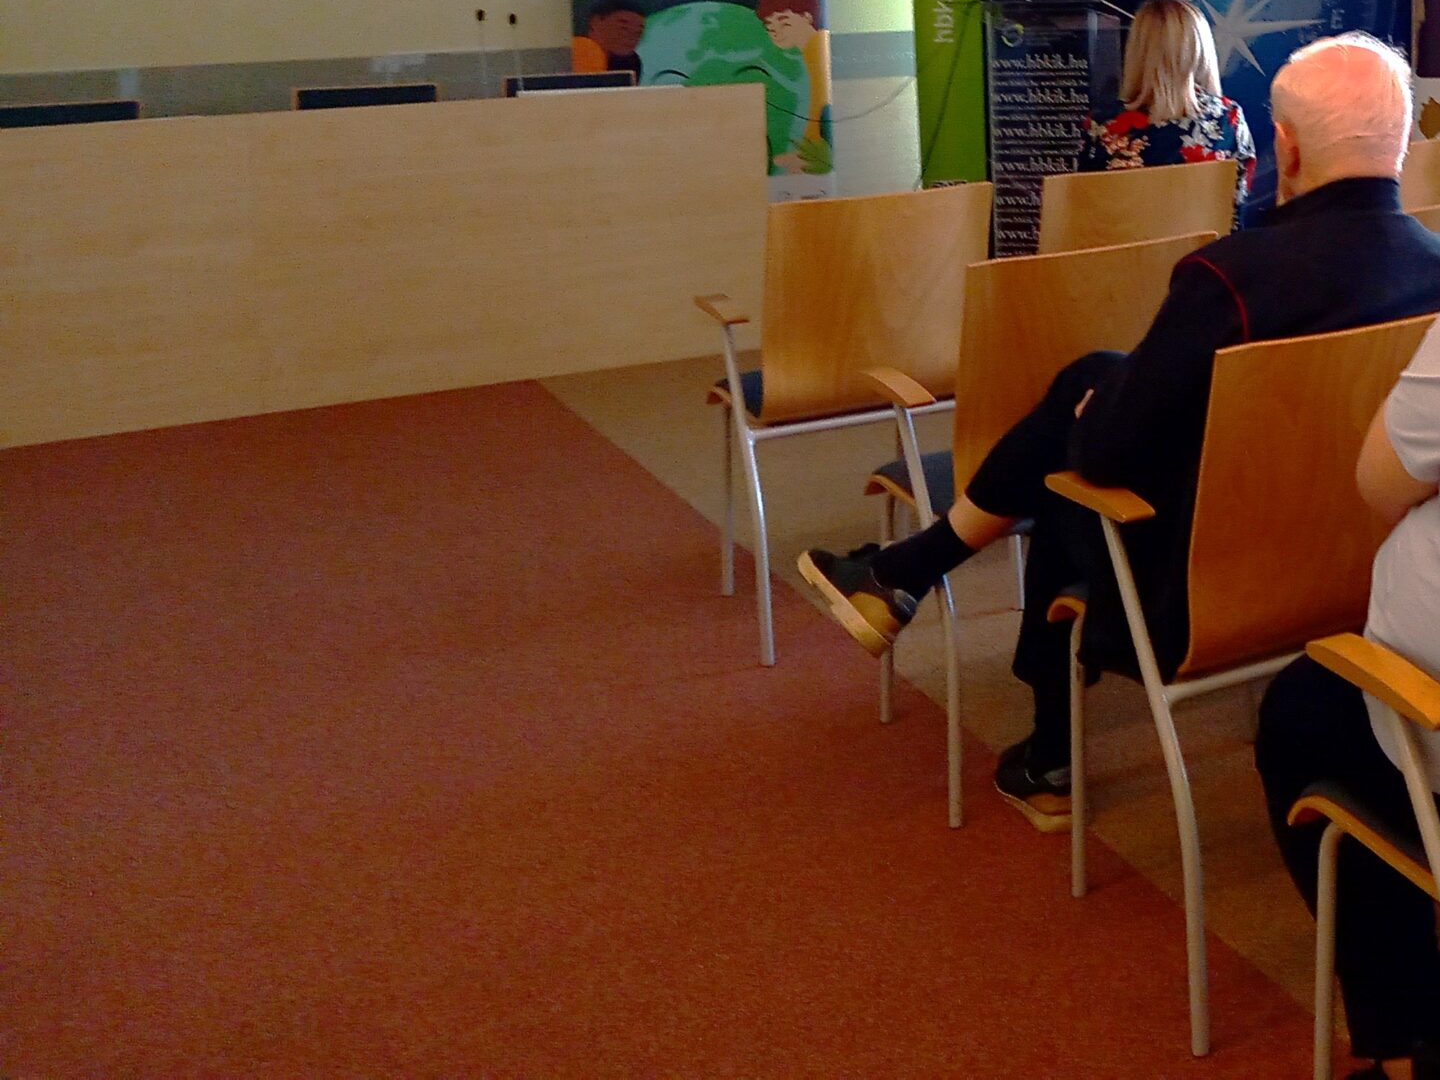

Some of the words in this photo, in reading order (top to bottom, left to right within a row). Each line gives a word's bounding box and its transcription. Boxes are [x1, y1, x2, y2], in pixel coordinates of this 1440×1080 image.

[992, 53, 1088, 69] www.hbkik.hu
[994, 87, 1089, 104] www.hbkik.hu
[994, 122, 1081, 138] www.hbkik.h
[996, 157, 1078, 172] www.hbkik.
